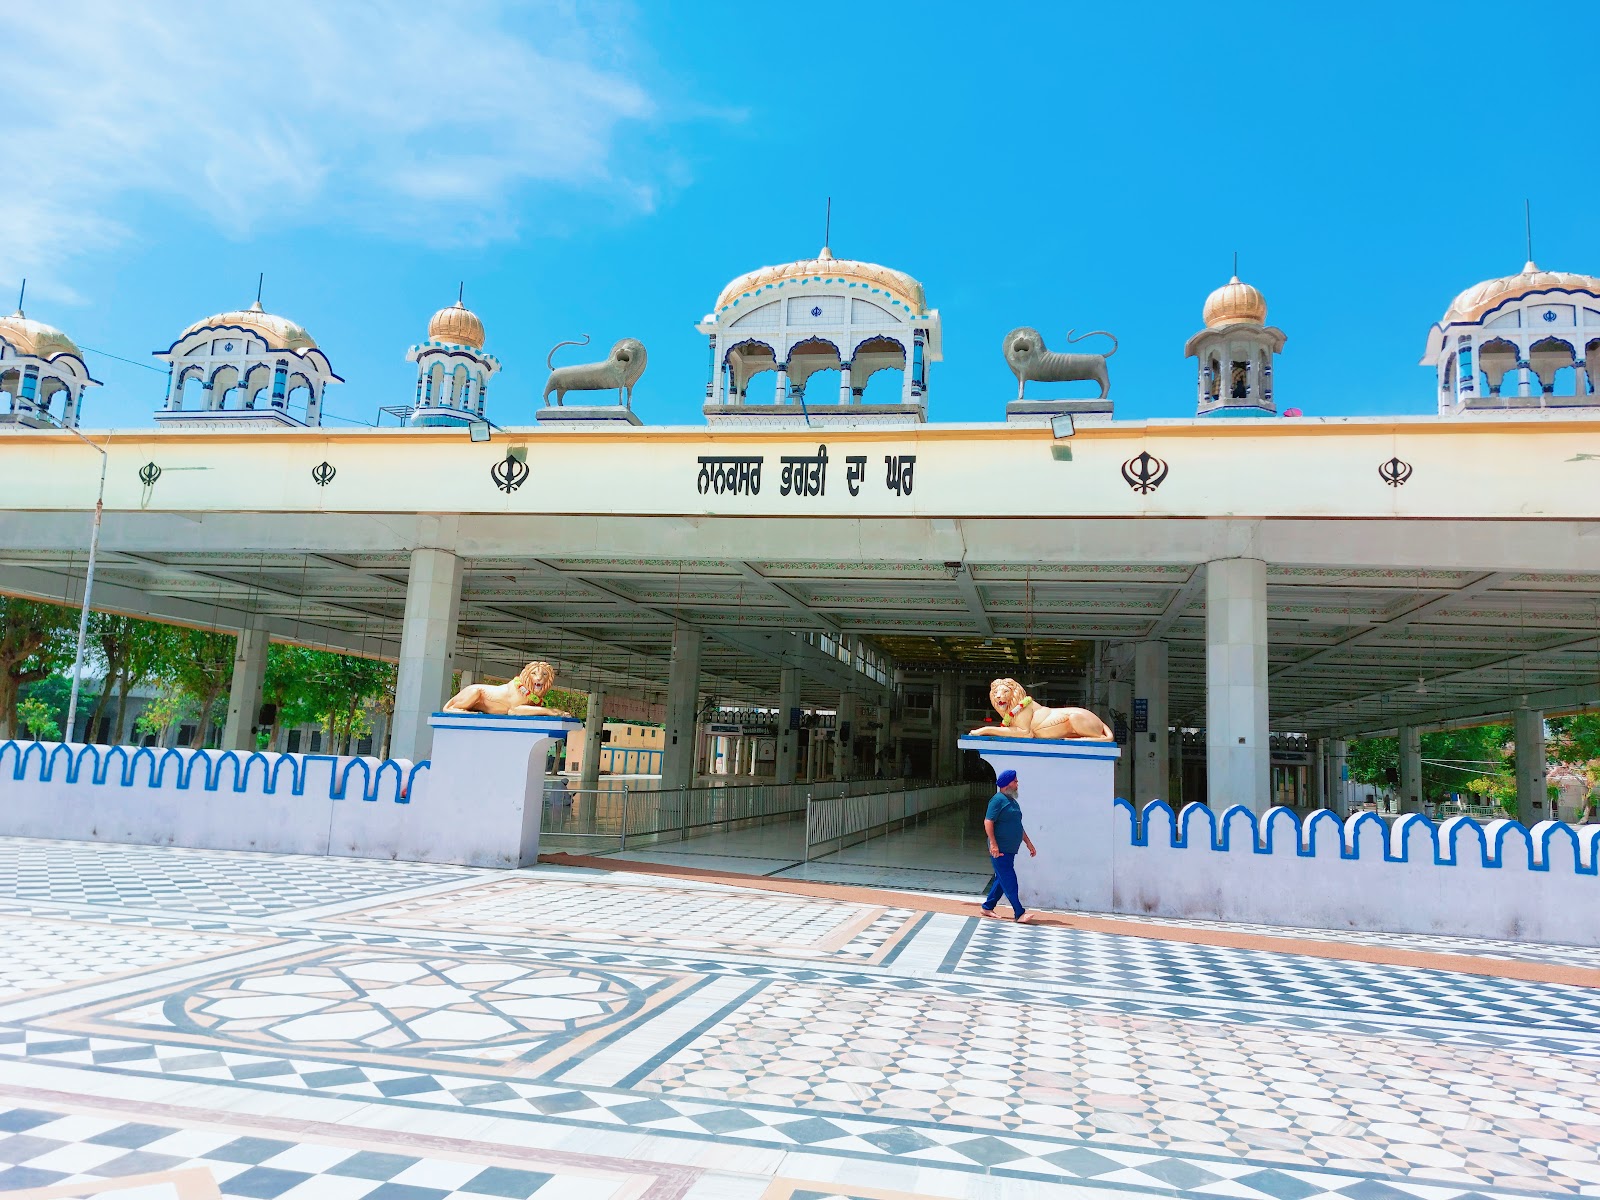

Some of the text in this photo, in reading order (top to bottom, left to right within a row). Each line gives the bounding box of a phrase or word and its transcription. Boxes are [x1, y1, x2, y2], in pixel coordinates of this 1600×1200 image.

[697, 444, 916, 497] ਨਾਨਕਸਰ ਭਗਤੀ ਦਾ ਘਰ
